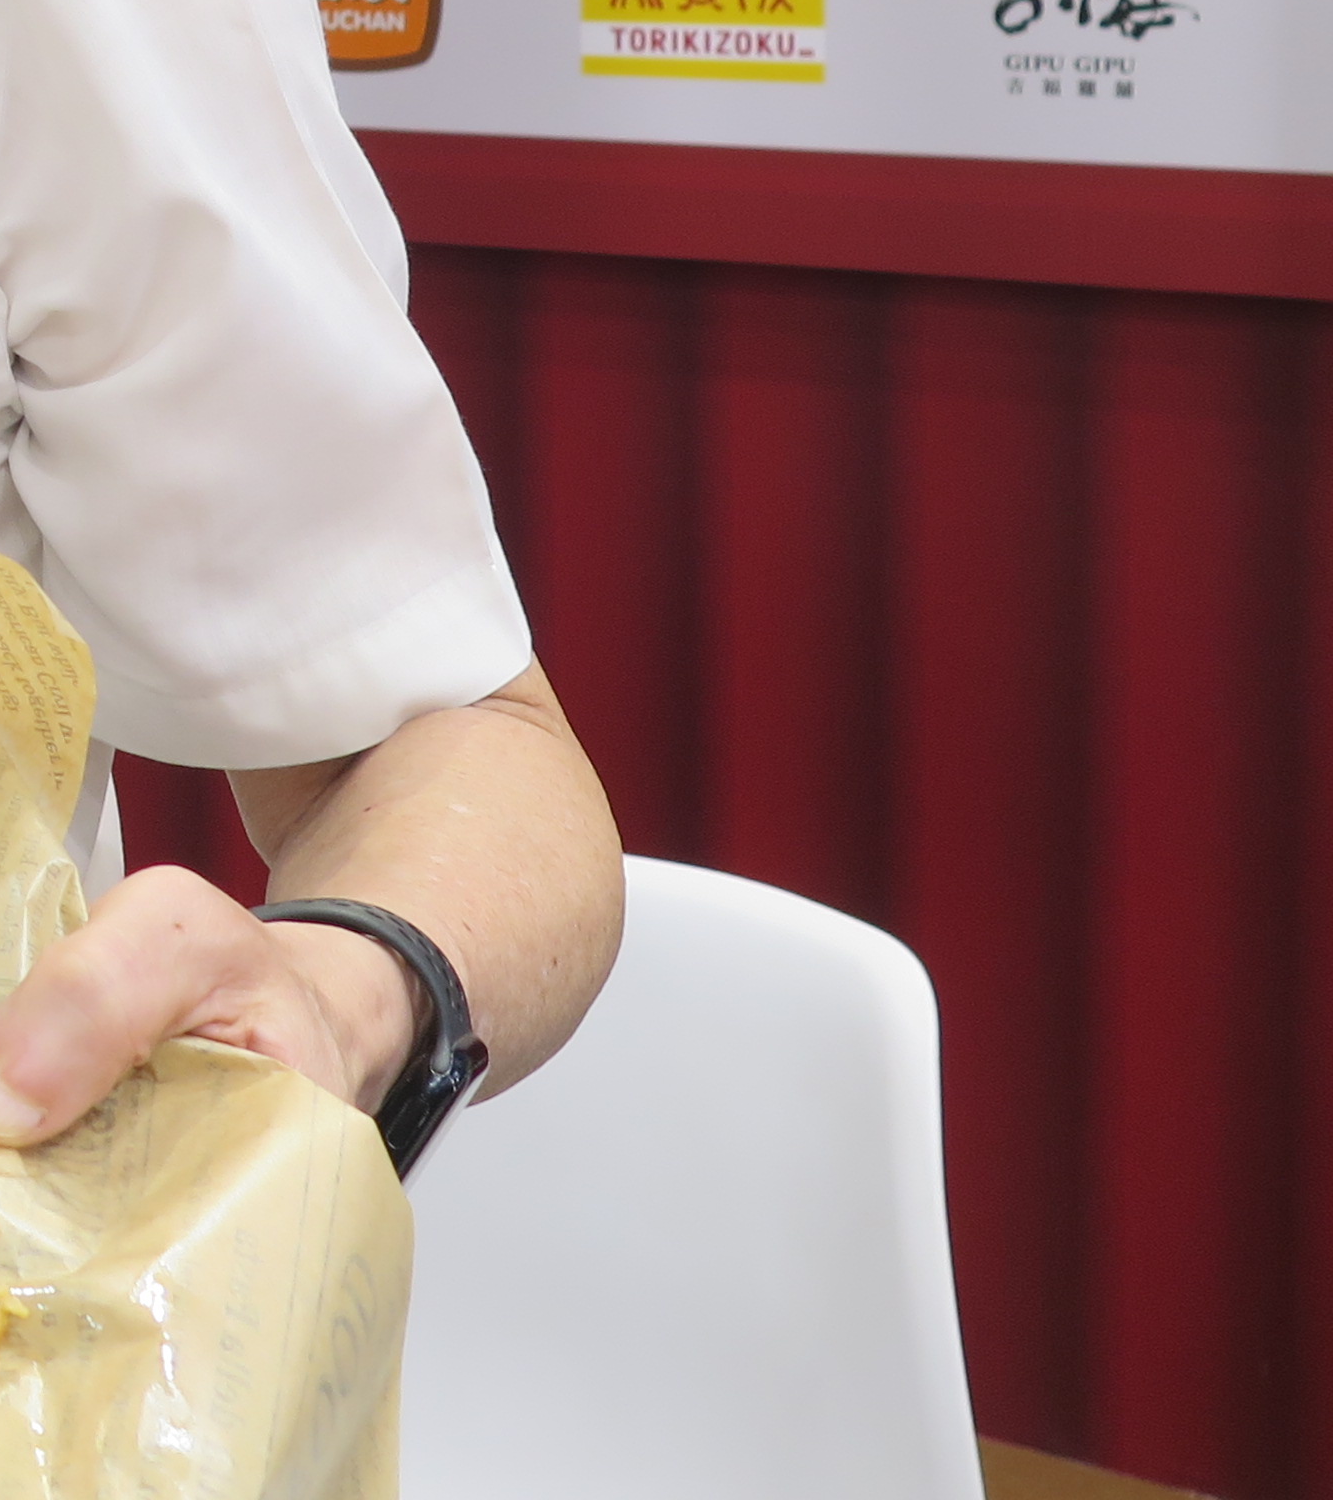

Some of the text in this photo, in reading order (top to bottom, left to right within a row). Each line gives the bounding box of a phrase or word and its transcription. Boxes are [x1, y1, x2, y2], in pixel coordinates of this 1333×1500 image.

[317, 9, 406, 32] UCHAN
[611, 27, 795, 57] TORIKIZOKU
[1003, 52, 1135, 75] GIPU GIPU
